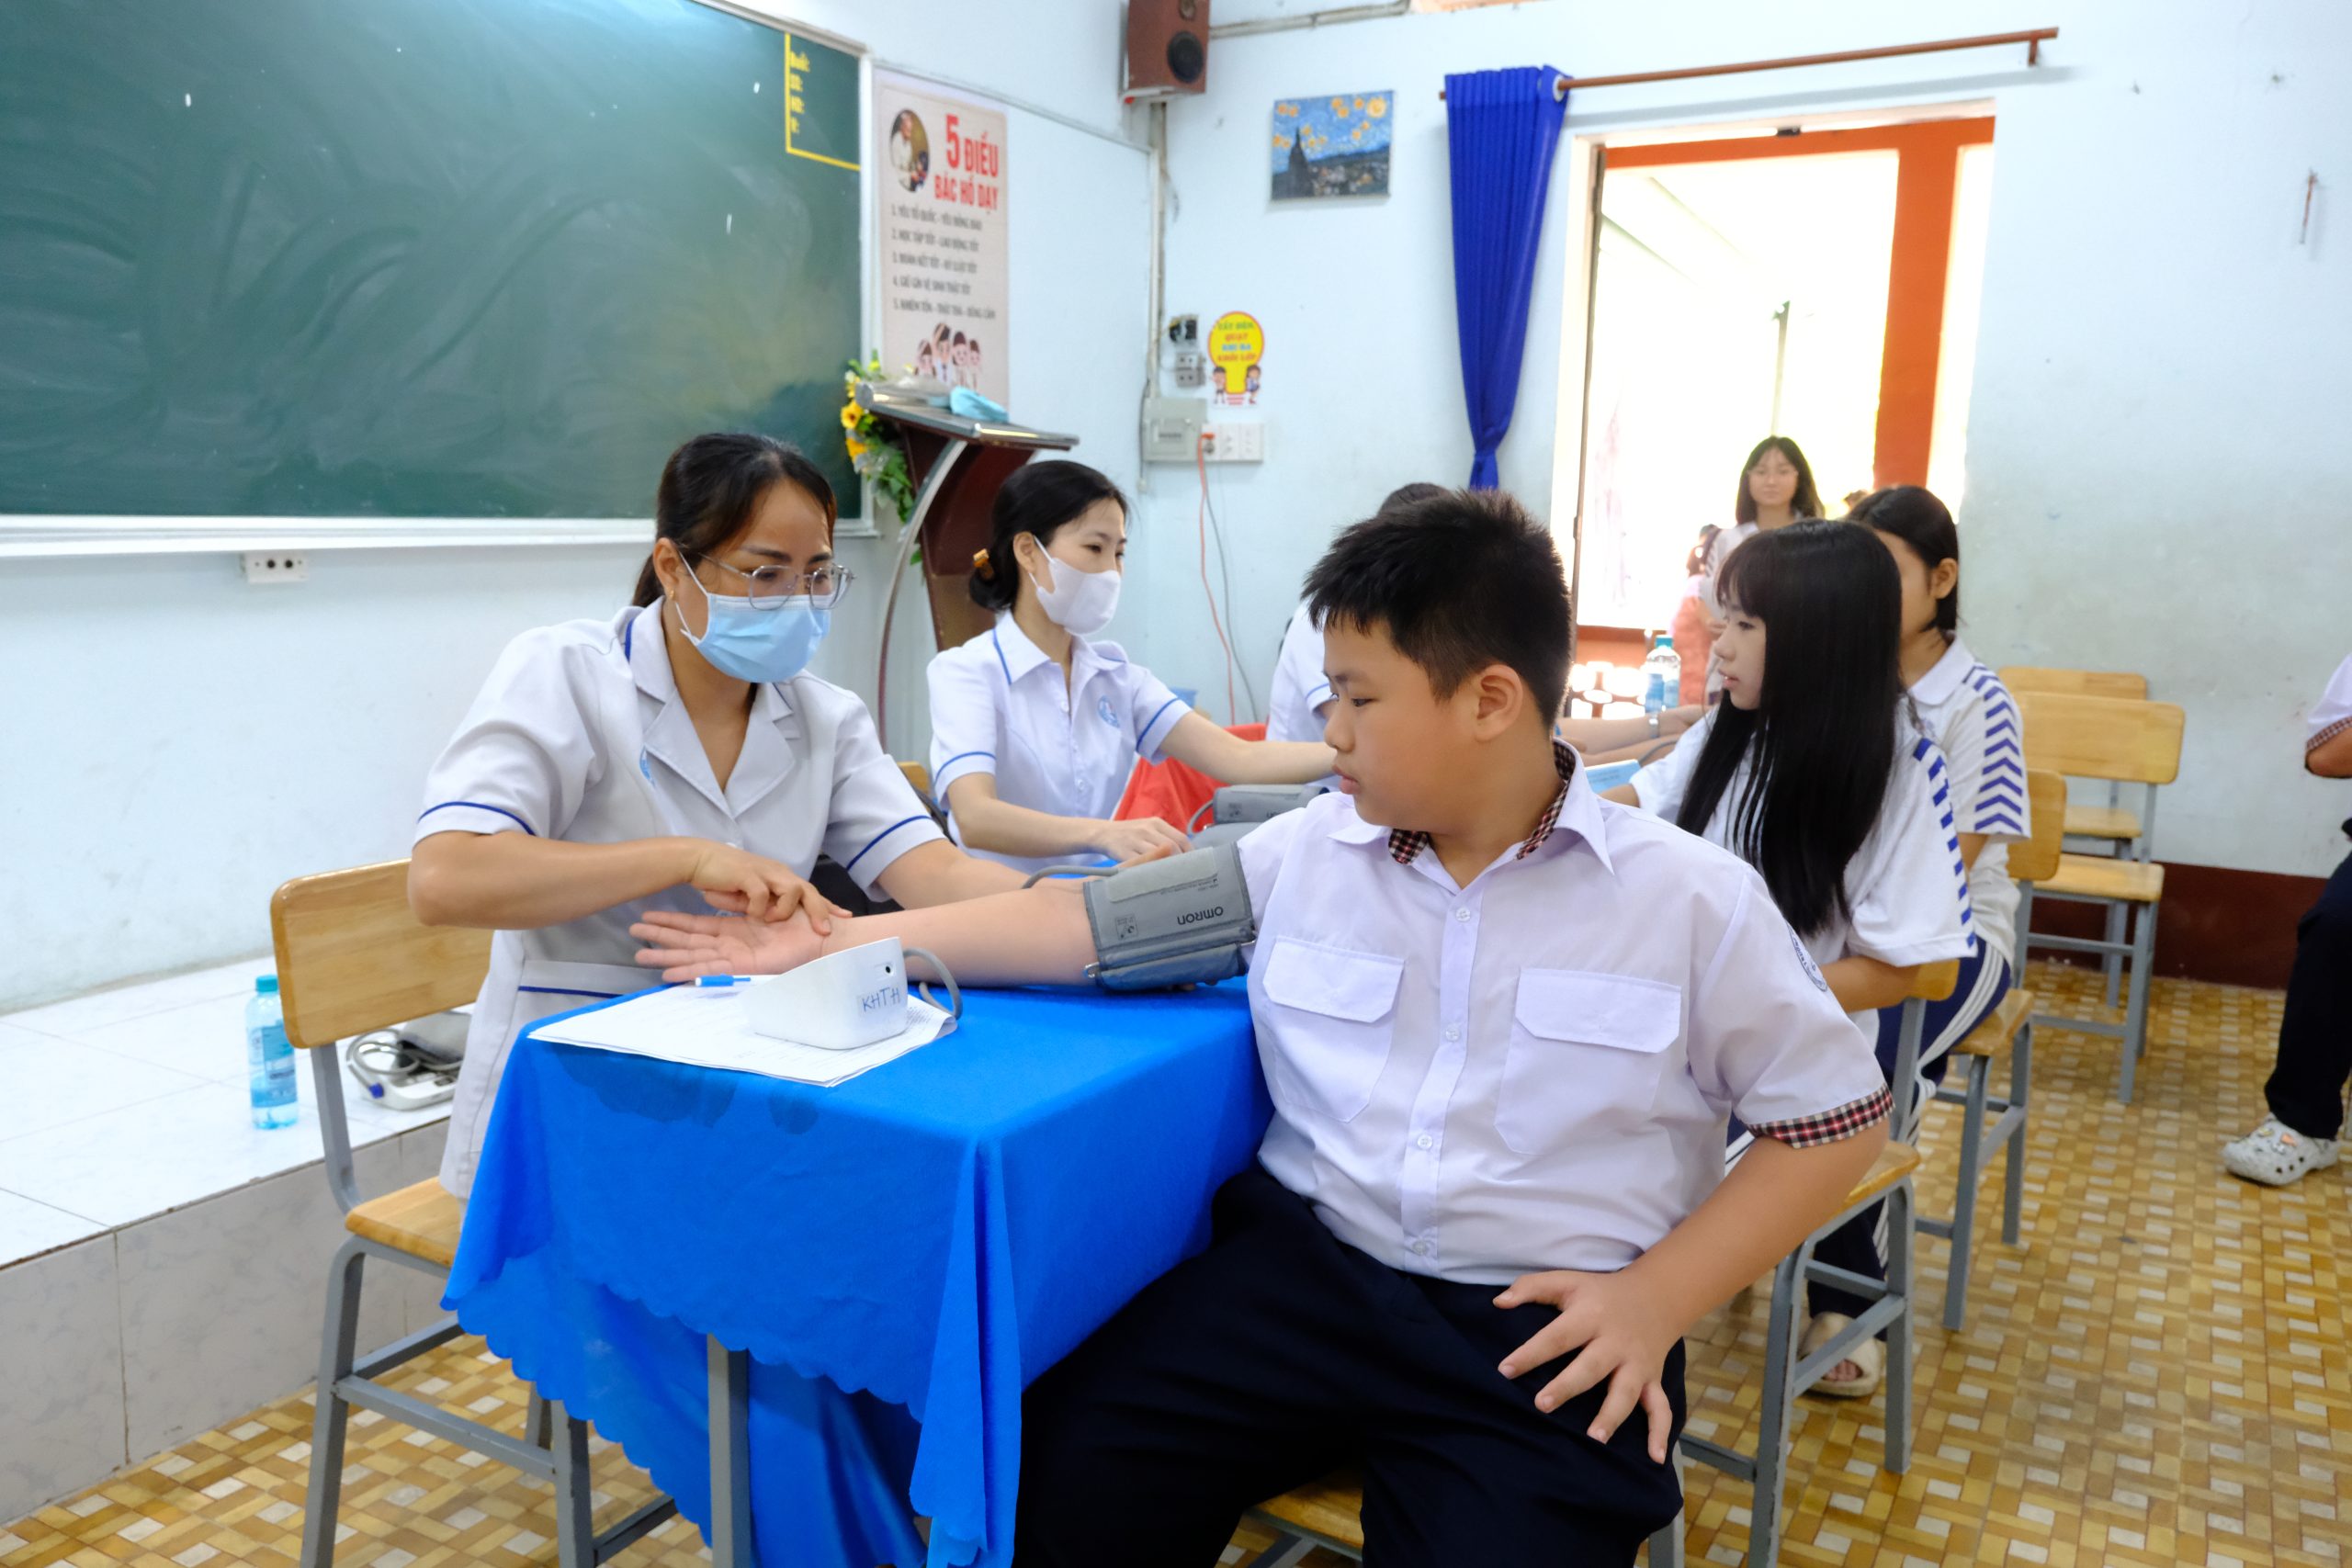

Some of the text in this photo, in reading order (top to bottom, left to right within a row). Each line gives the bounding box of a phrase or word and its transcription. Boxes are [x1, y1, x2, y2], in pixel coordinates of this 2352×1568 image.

[945, 113, 960, 168] 5
[1177, 906, 1224, 925] OMRON
[862, 987, 900, 1011] KHTH
